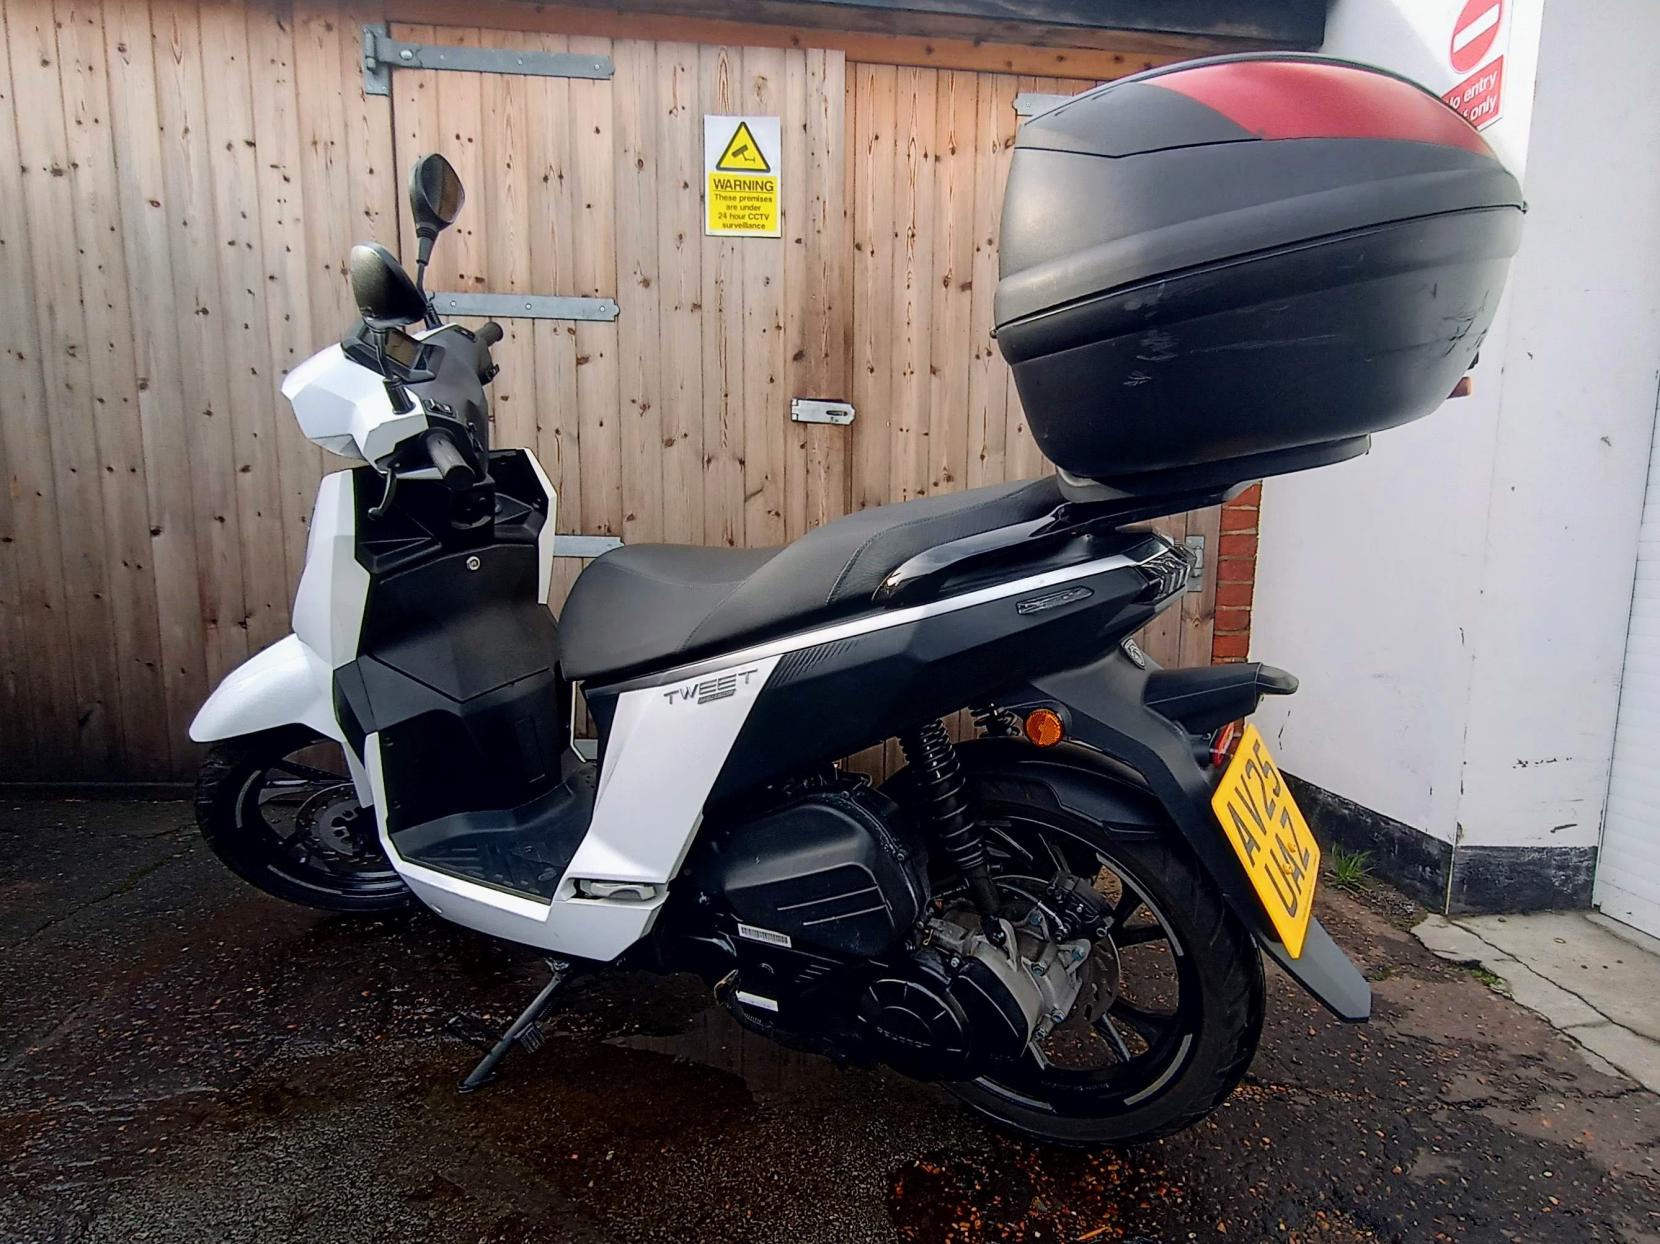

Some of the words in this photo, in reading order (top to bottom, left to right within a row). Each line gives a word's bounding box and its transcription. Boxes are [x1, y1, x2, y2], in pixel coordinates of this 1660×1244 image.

[1464, 70, 1498, 102] entry
[1470, 95, 1497, 120] only
[713, 178, 774, 192] WARNING
[715, 193, 737, 202] These
[739, 195, 773, 203] premises
[740, 203, 761, 211] under
[718, 211, 728, 219] 24
[730, 211, 746, 220] hour
[748, 212, 770, 220] CCTV
[722, 221, 766, 229] surveillance
[663, 668, 758, 705] TWEET
[1227, 739, 1281, 868] AV25
[1265, 806, 1310, 918] UAZ
